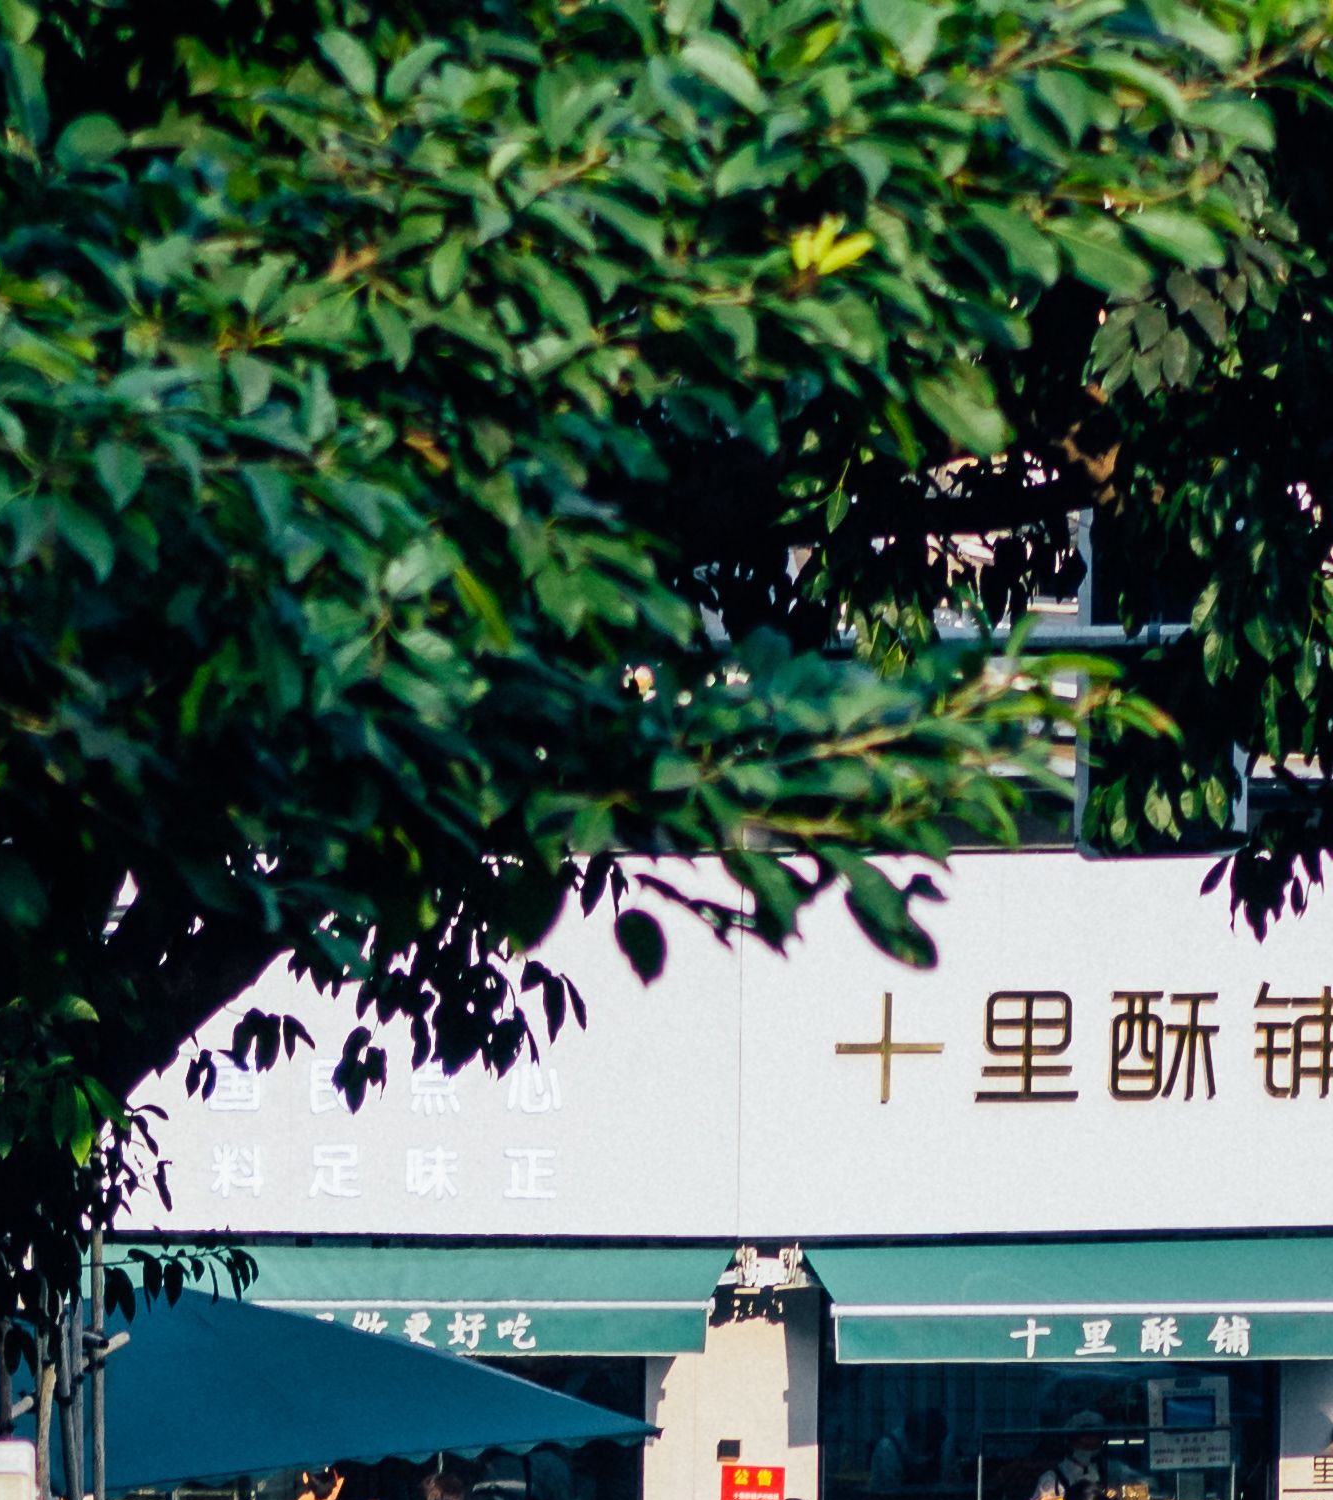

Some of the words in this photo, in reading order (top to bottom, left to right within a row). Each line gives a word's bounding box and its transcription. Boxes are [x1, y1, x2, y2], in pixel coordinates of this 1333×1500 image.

[835, 979, 1333, 1105] 十里酥铺
[210, 1143, 558, 1200] 料足味正
[316, 1311, 536, 1350] 更好吃
[1010, 1314, 1251, 1358] 十里酥铺
